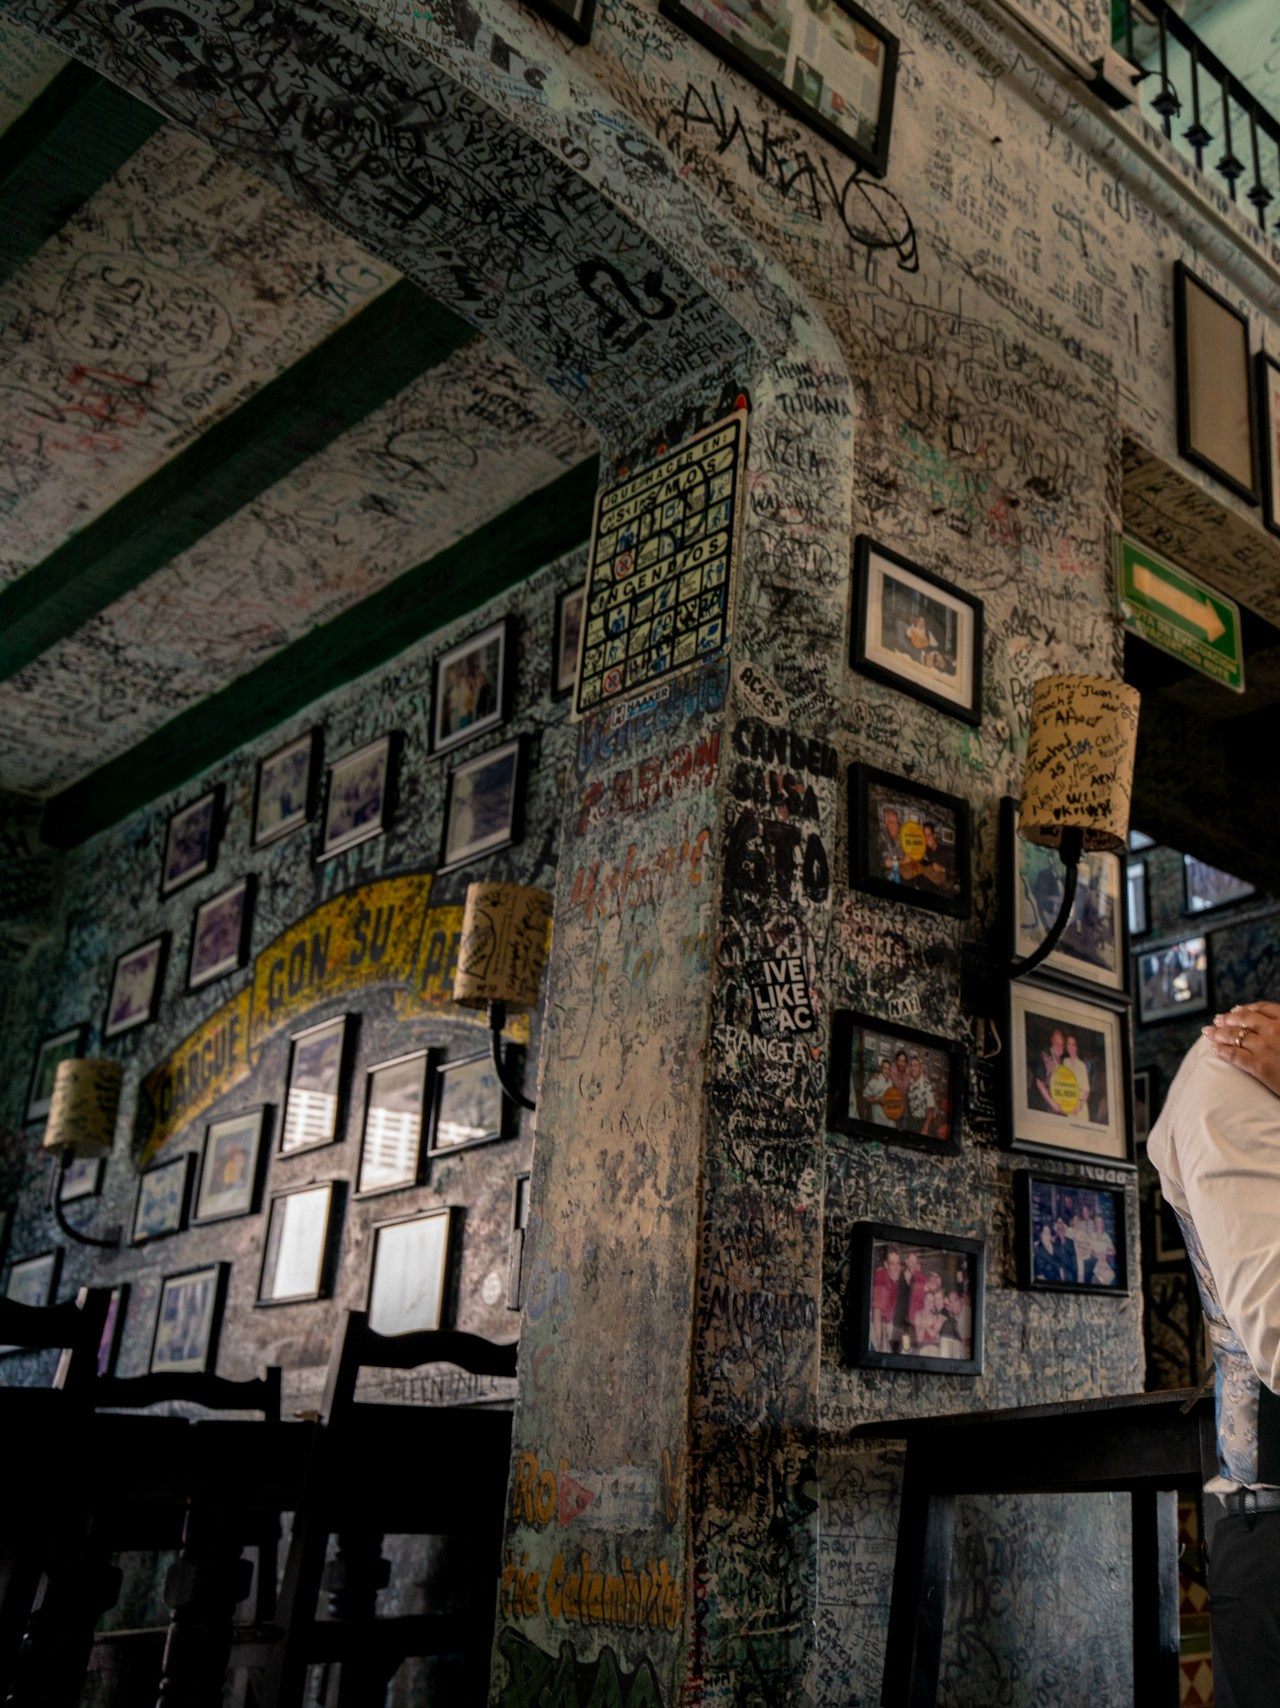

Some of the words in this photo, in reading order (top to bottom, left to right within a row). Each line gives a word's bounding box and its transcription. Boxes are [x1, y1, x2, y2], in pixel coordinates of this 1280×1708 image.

[627, 688, 668, 712] HAAKER
[268, 925, 332, 1010] CON
[350, 904, 395, 966] SU
[753, 984, 808, 1010] LIKE
